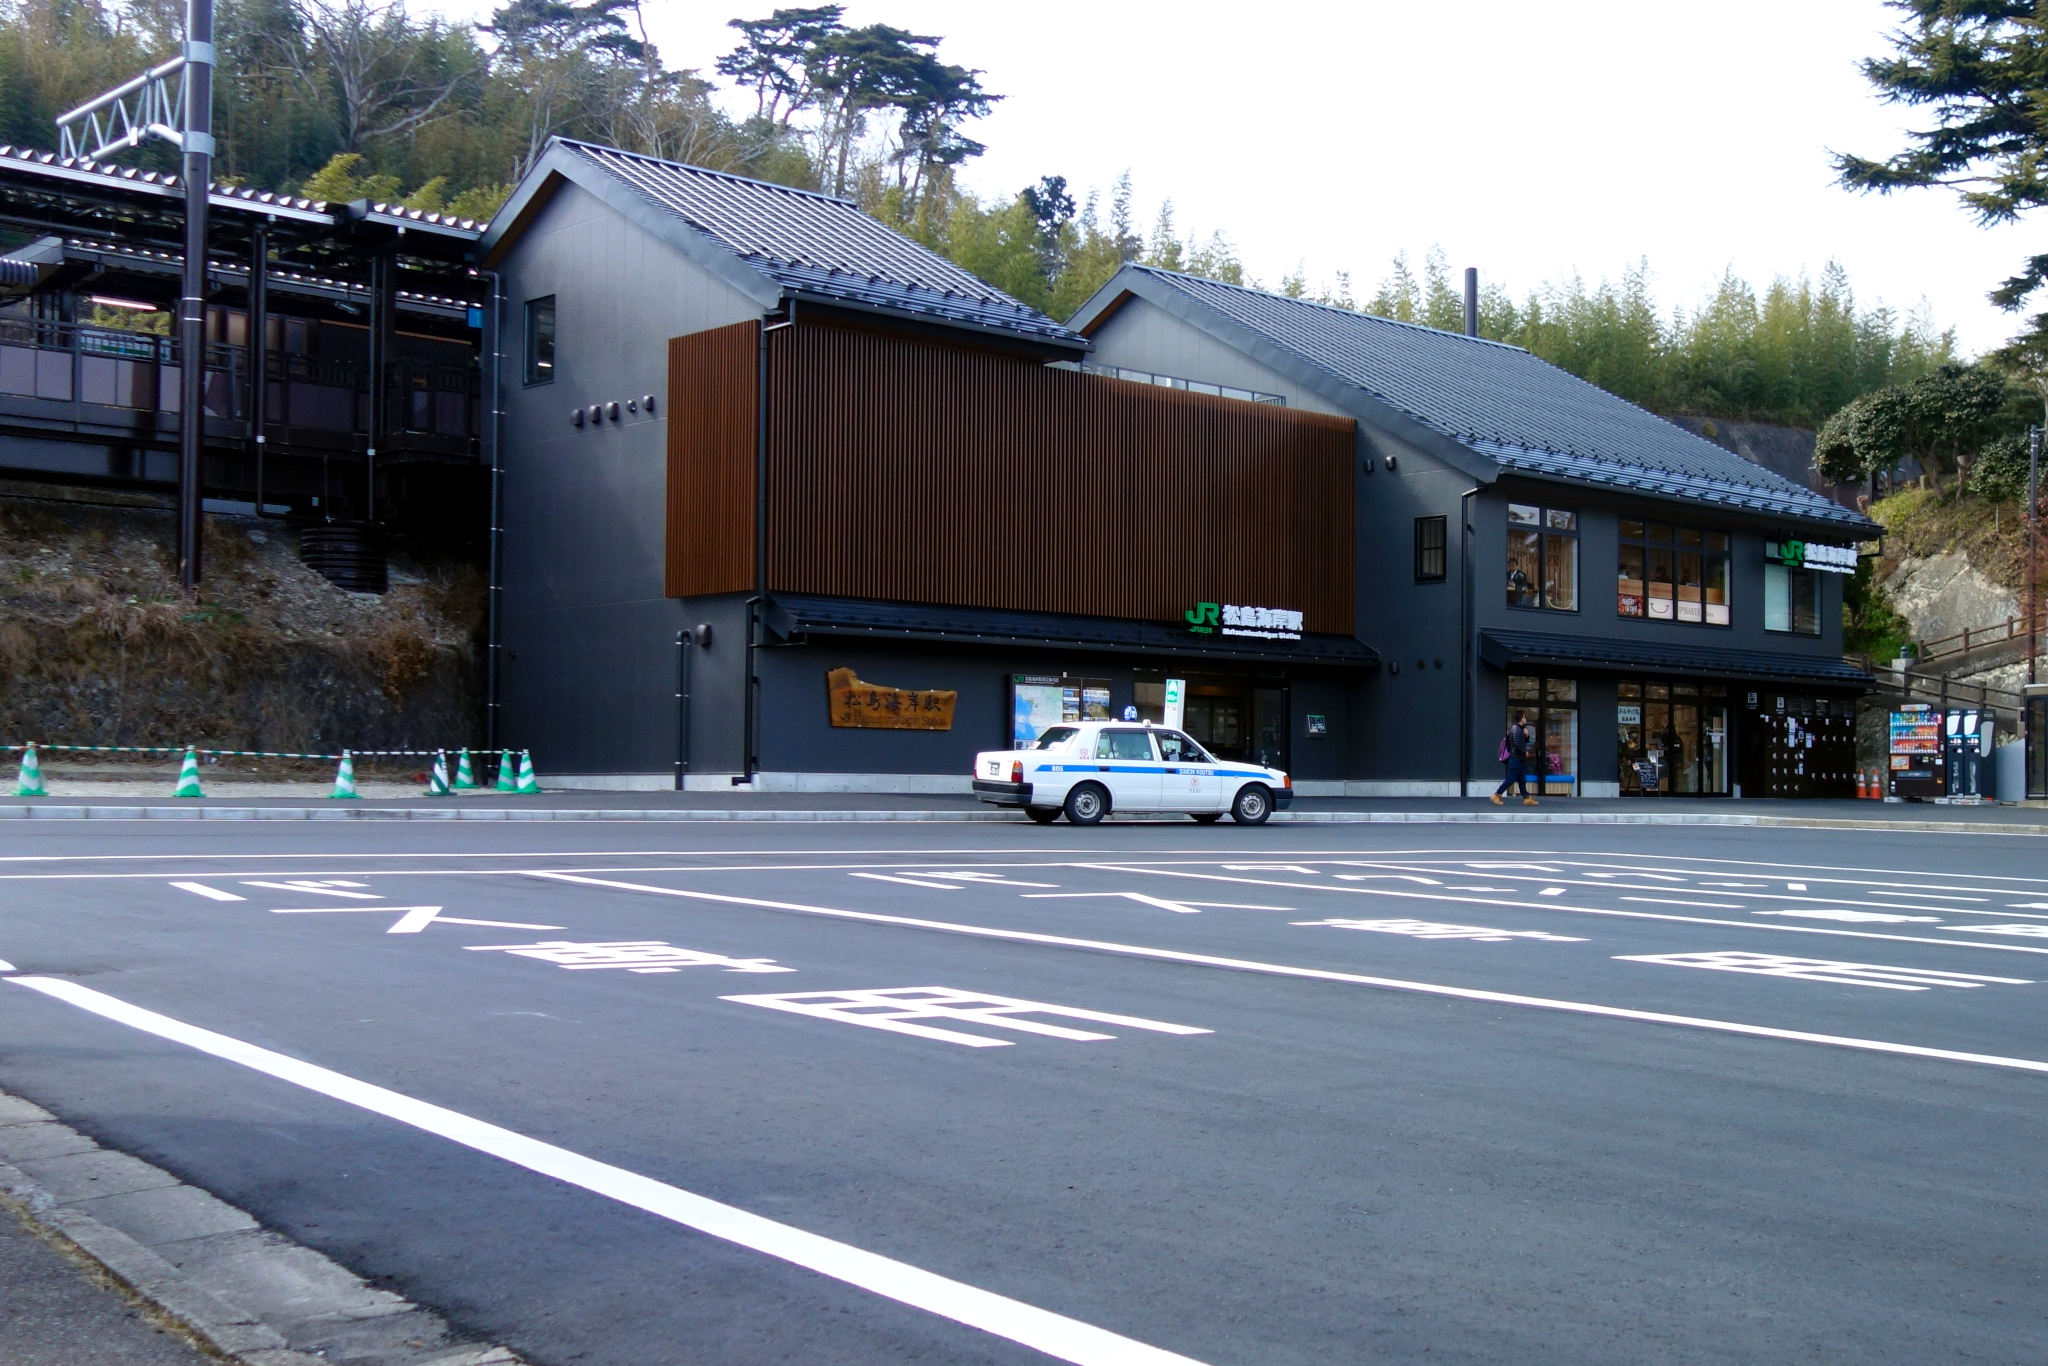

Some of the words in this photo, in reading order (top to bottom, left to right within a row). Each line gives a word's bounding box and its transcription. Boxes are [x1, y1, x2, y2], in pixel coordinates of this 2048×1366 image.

[1780, 540, 1804, 560] JR
[1185, 601, 1219, 626] JR
[1222, 604, 1303, 631] 松島海岸駅
[844, 690, 941, 712] 松島海岸駅
